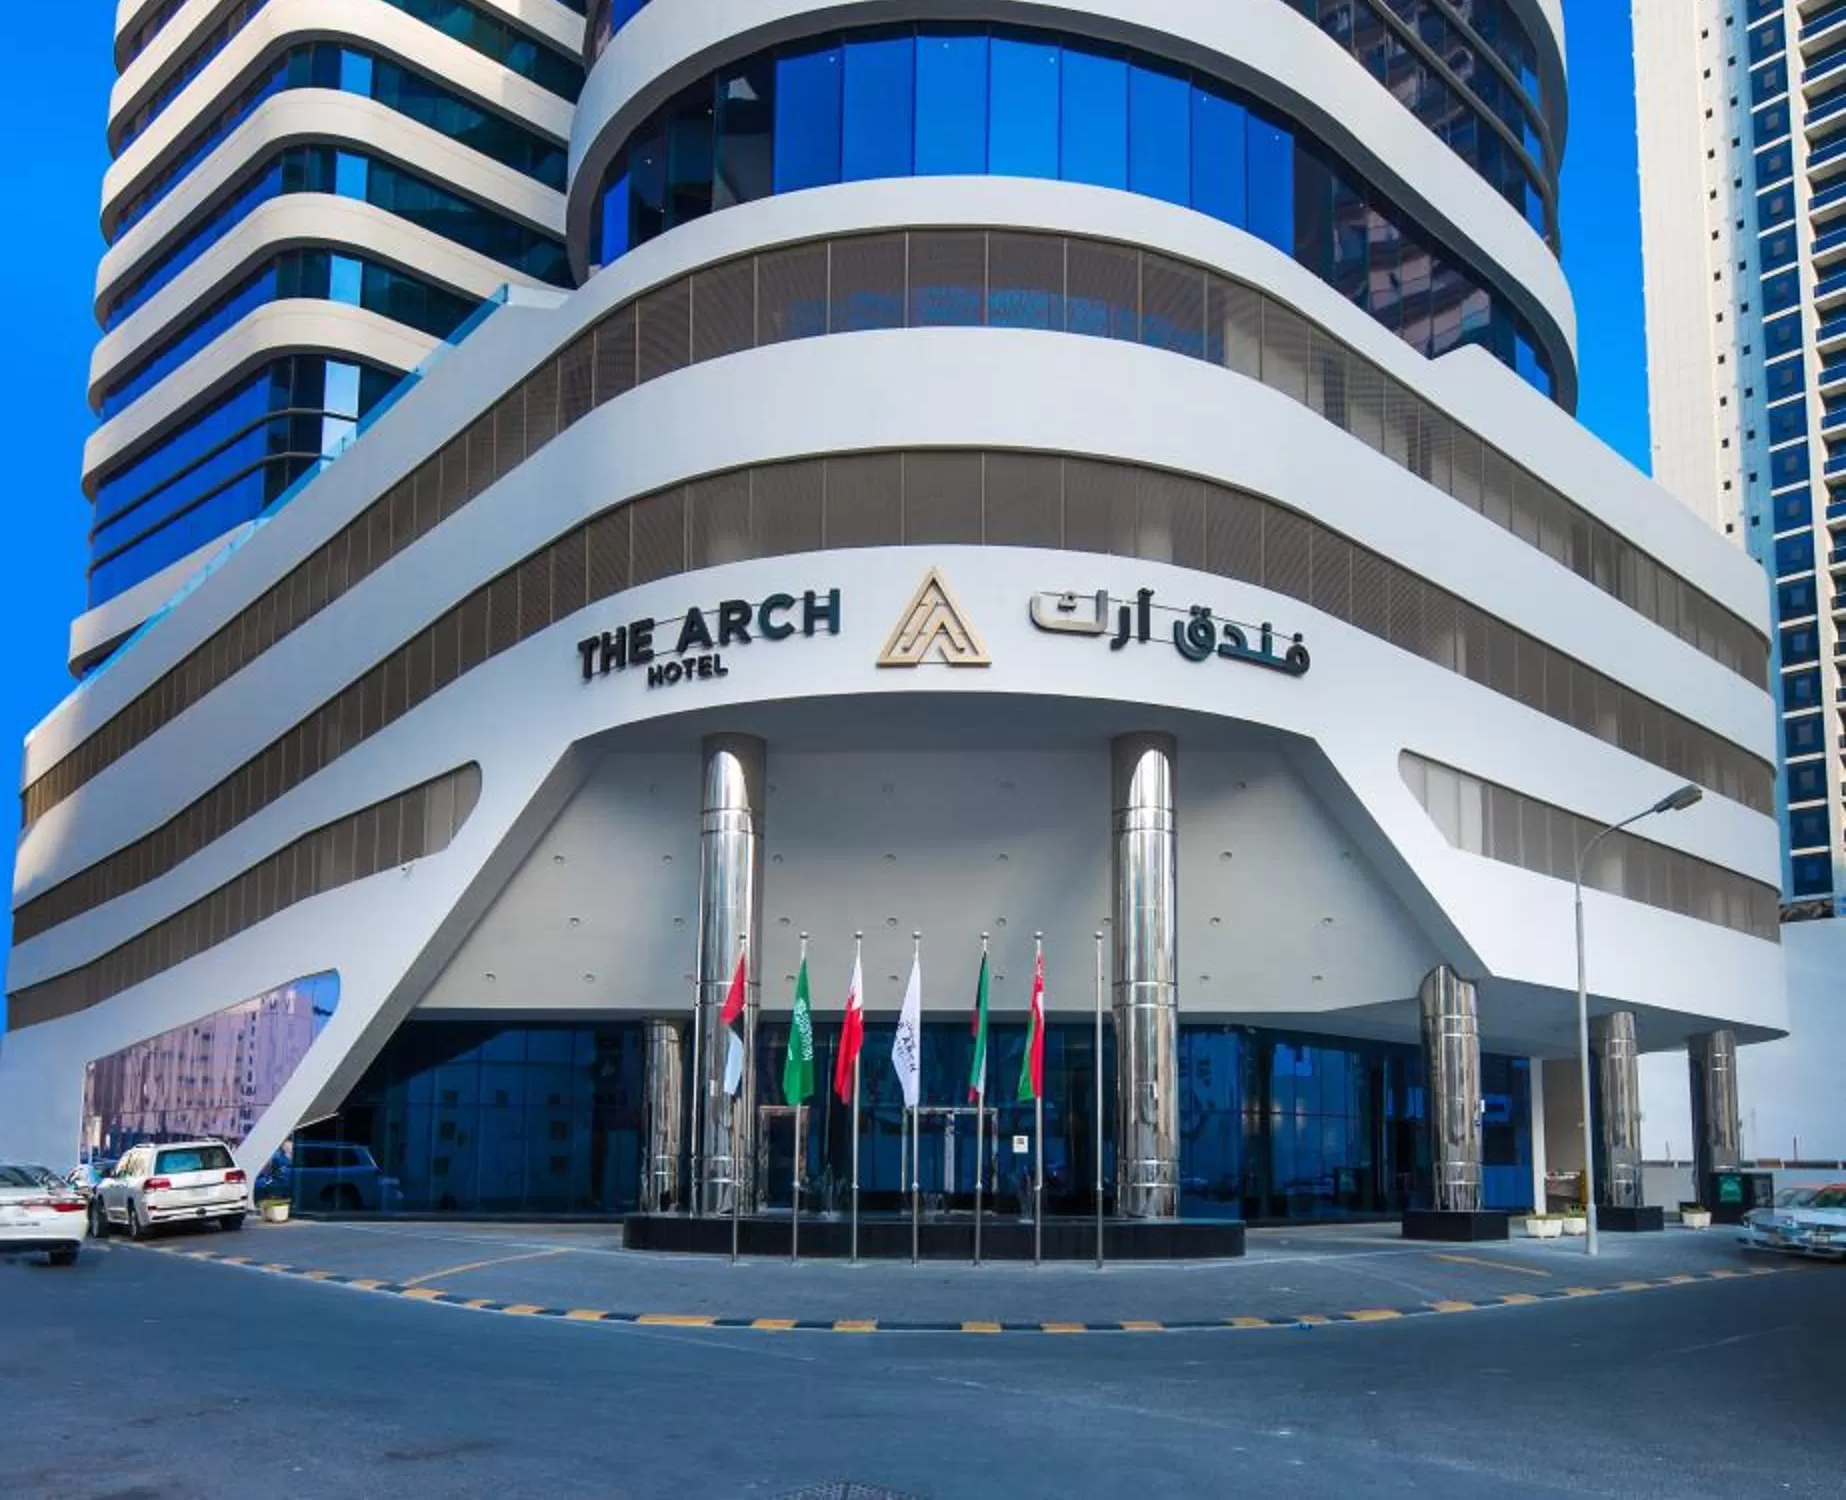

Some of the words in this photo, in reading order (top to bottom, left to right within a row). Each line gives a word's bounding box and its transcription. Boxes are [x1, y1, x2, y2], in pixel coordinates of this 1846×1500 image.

[577, 617, 655, 681] THE
[675, 588, 841, 654] ARCH
[1172, 604, 1311, 677] فندق
[648, 653, 729, 690] HOTEL
